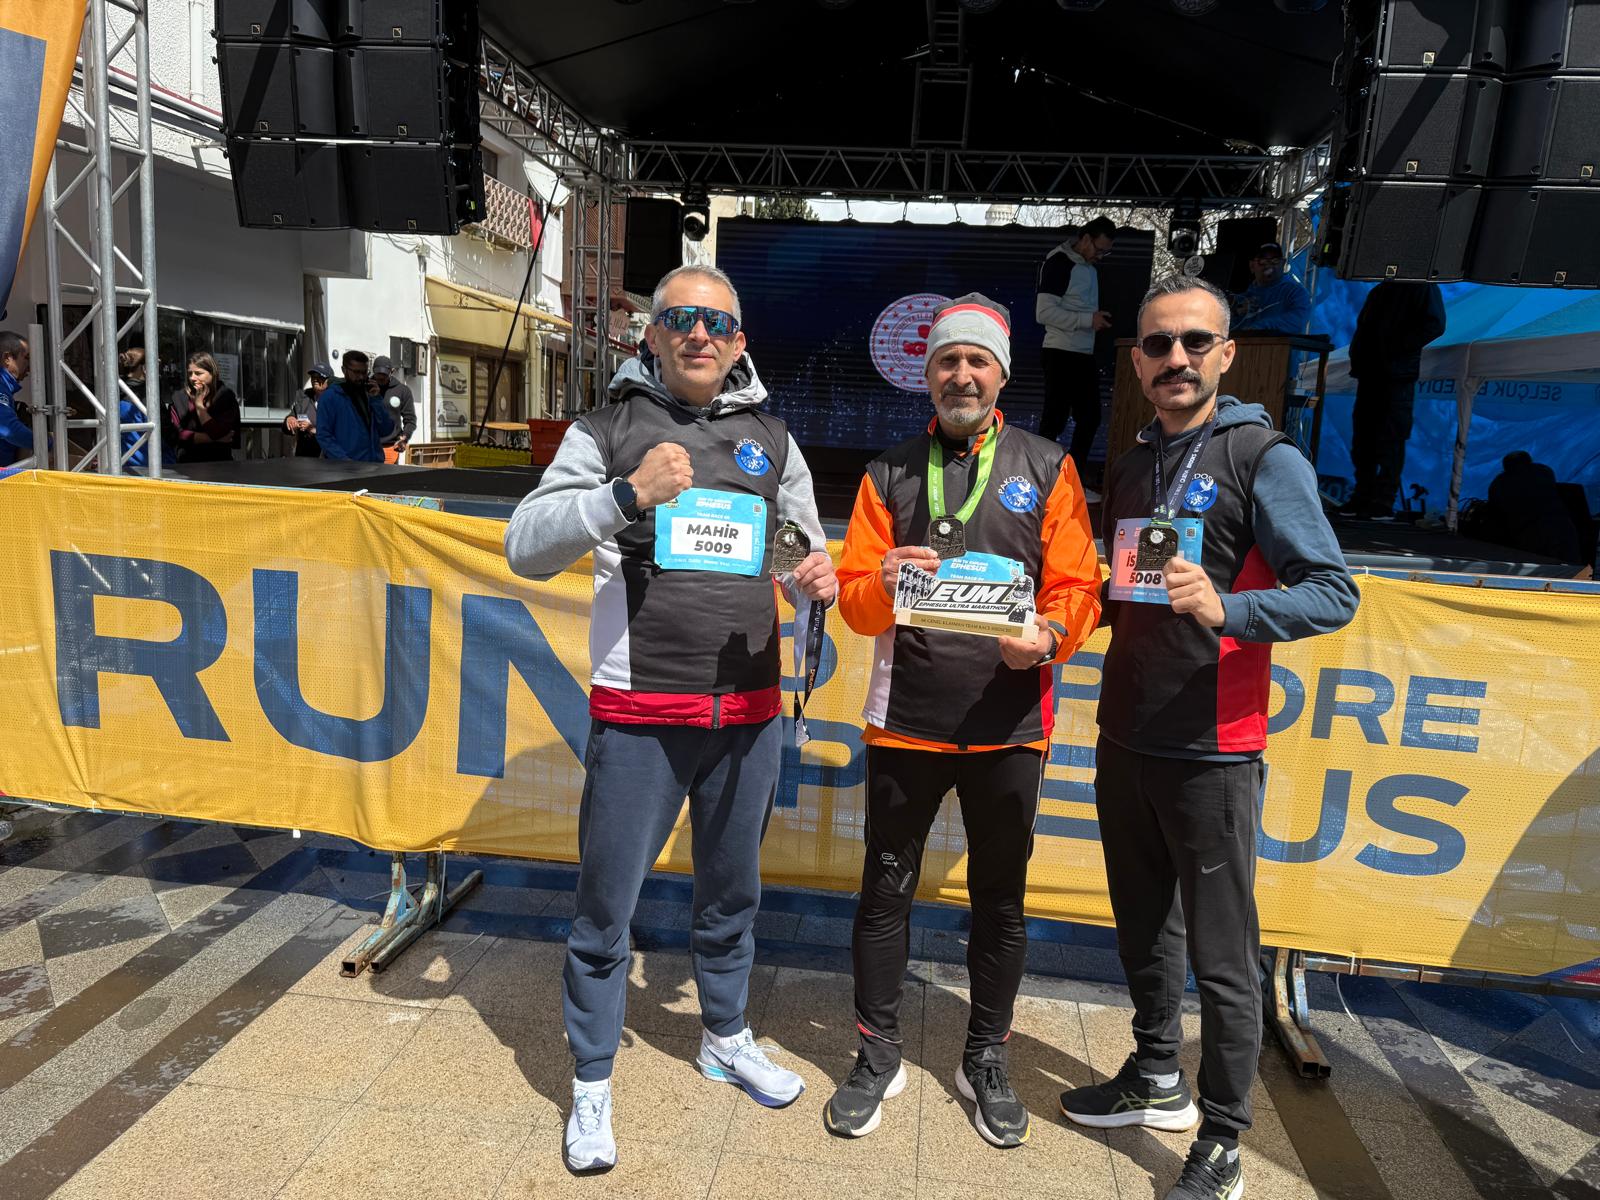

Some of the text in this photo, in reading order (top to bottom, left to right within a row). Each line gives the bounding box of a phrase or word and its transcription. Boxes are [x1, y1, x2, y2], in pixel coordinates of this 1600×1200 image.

[686, 523, 739, 539] MAHİR
[694, 540, 732, 554] 5009
[950, 563, 988, 572] EPHESUS
[1128, 572, 1162, 584] 5008
[930, 584, 1009, 603] EUM
[50, 549, 591, 779] RUN
